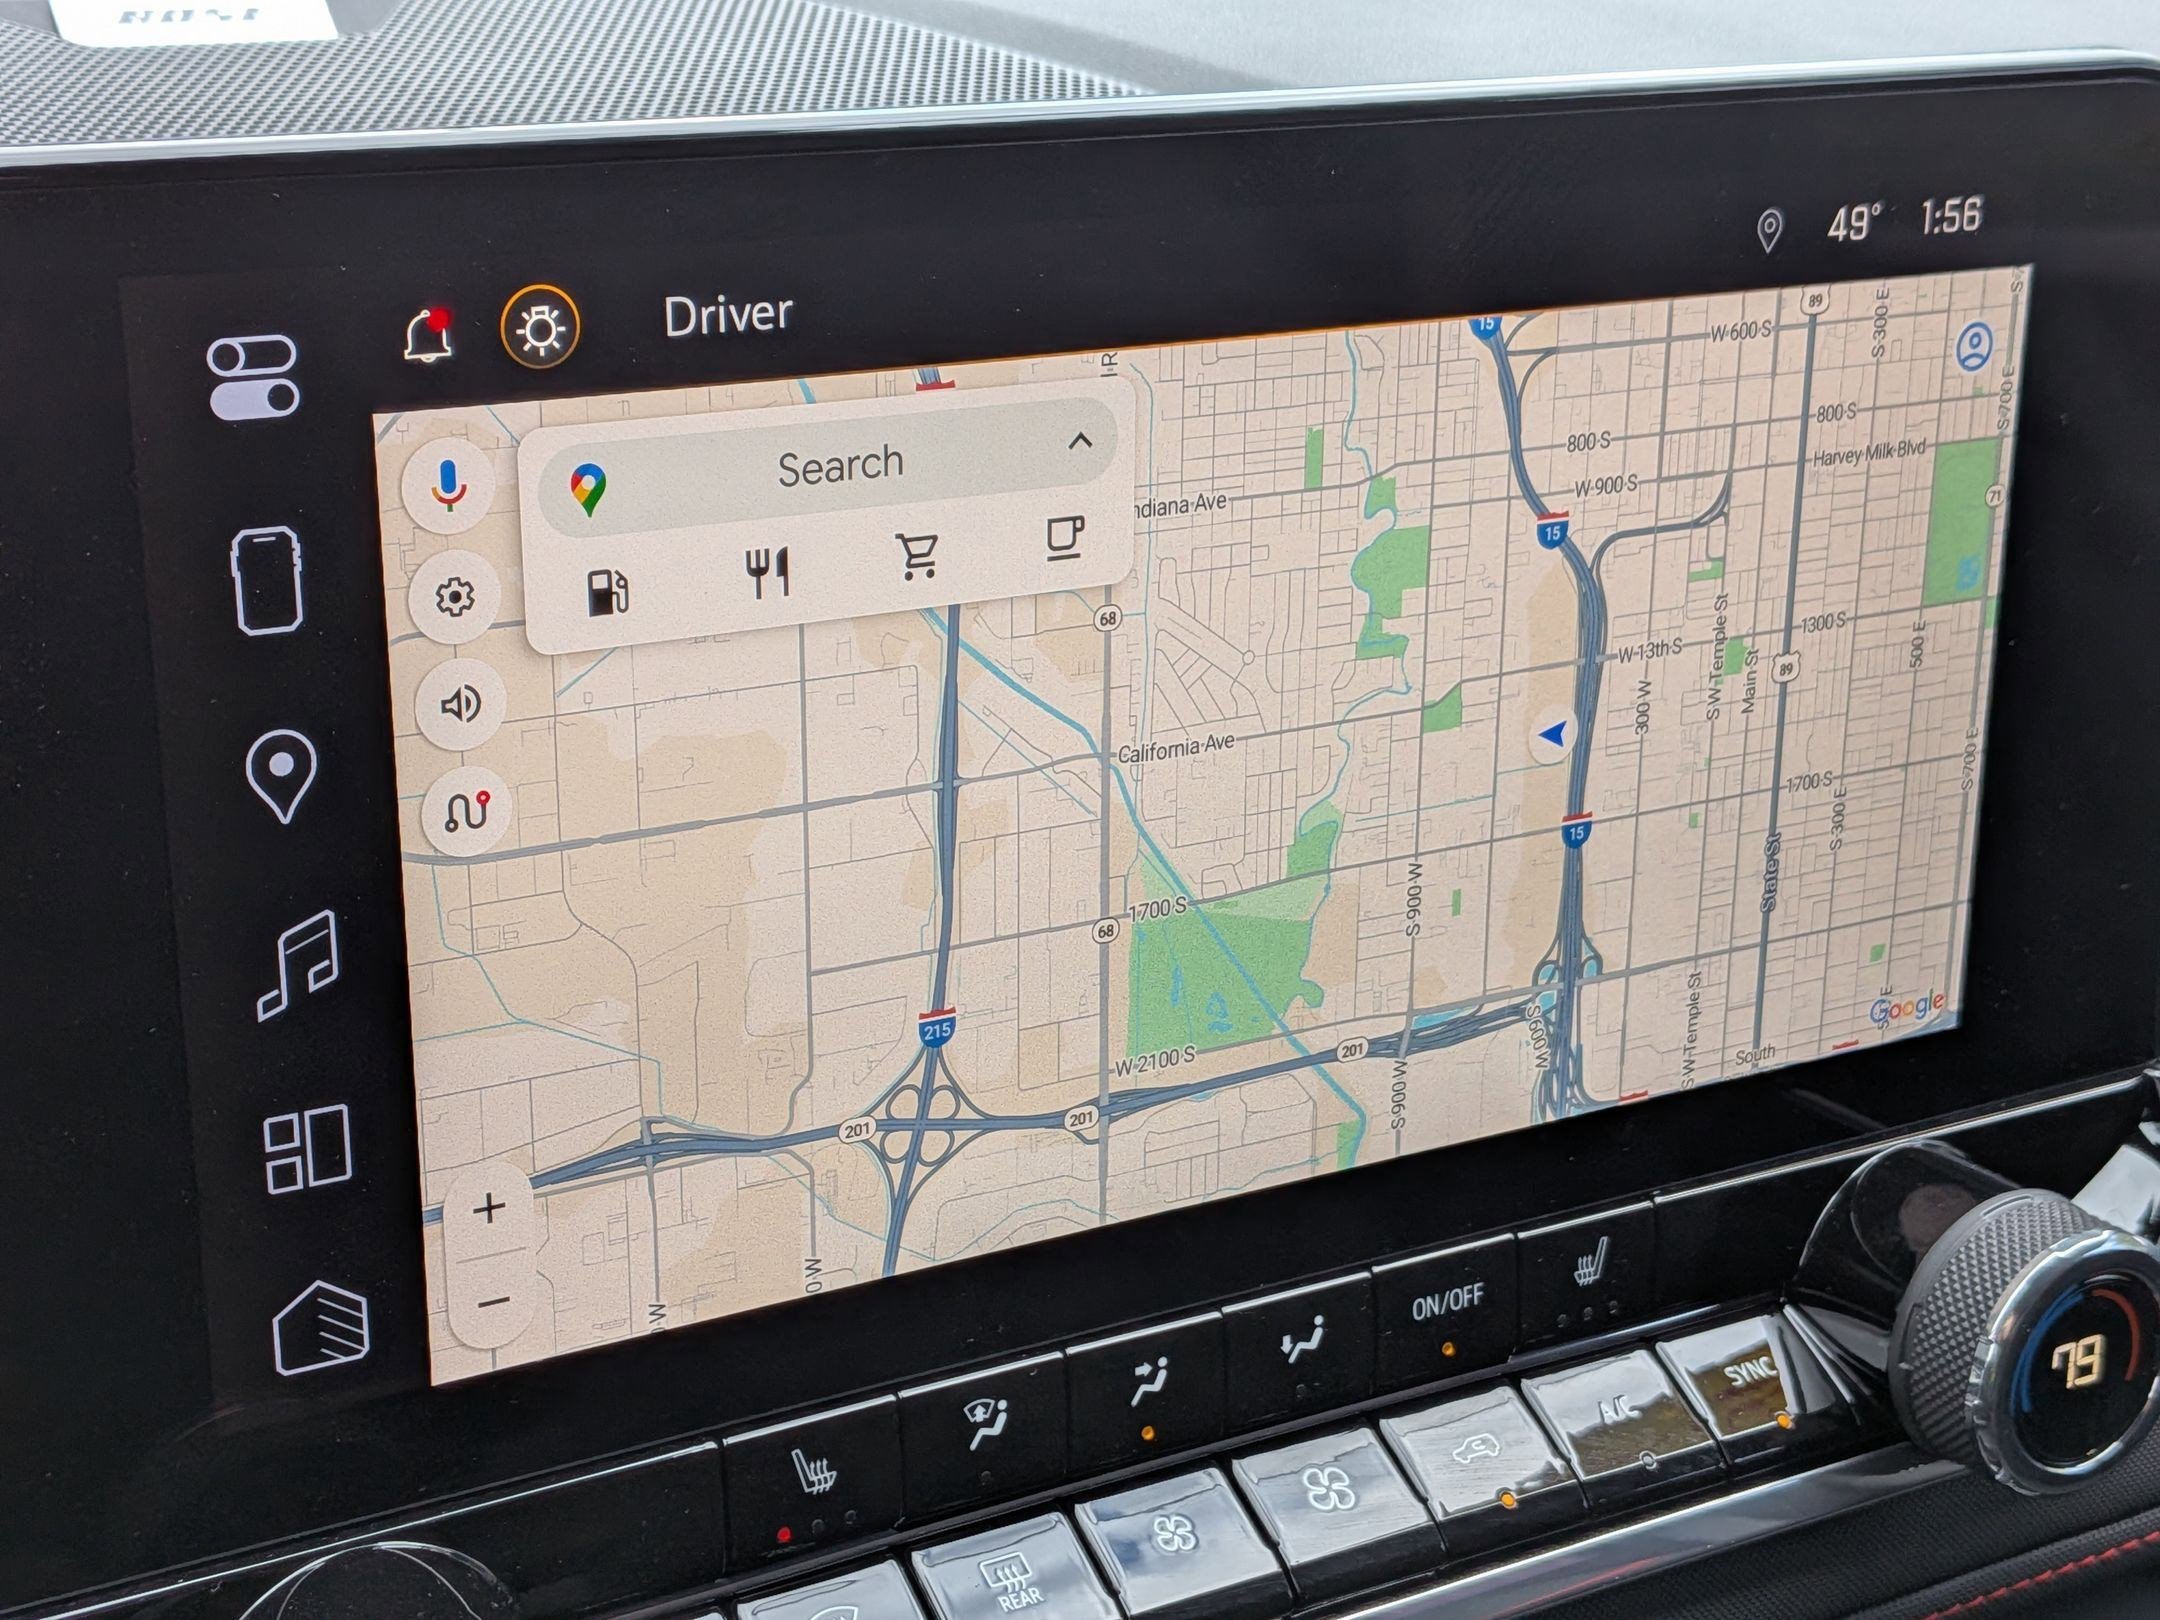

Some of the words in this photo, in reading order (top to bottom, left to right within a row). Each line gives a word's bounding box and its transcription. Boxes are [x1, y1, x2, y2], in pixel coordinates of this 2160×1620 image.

[1828, 202, 1882, 242] 49°
[1922, 195, 1985, 235] 1:56
[1809, 294, 1823, 307] 89
[1877, 288, 1889, 300] E
[665, 294, 793, 337] Driver
[1480, 317, 1494, 330] 15
[1874, 305, 1888, 341] 300
[1711, 326, 1726, 342] W
[1730, 322, 1758, 340] 600
[1762, 320, 1771, 336] S
[1872, 344, 1885, 358] S
[2002, 366, 2014, 377] E
[1998, 382, 2012, 416] 700
[1817, 404, 1843, 422] 800
[1847, 403, 1856, 419] S
[1997, 420, 2009, 430] S
[1567, 433, 1596, 452] 800
[1600, 431, 1611, 447] S
[1813, 448, 1862, 467] Harvey
[1866, 444, 1893, 460] Milk
[1898, 438, 1926, 457] Blvd
[779, 443, 903, 487] Search
[1575, 480, 1591, 498] W
[1595, 476, 1624, 494] 900
[1627, 474, 1638, 490] S
[1194, 493, 1227, 512] Ave
[1989, 490, 2001, 503] 71
[1545, 526, 1560, 540] 15
[1715, 593, 1728, 611] St
[1100, 611, 1117, 626] 68
[1801, 615, 1833, 633] 1300
[1836, 612, 1846, 626] S
[1914, 621, 1926, 632] E
[1619, 649, 1635, 663] W
[1638, 640, 1672, 659] 13th
[1673, 637, 1683, 653] S
[1711, 614, 1727, 680] Temple
[1910, 636, 1924, 668] 500
[1745, 649, 1759, 666] St
[1780, 663, 1793, 676] 89
[1637, 681, 1651, 698] W
[1708, 687, 1721, 705] W
[1741, 671, 1757, 714] Main
[1635, 702, 1650, 735] 300
[1707, 709, 1720, 720] S
[1966, 728, 1979, 738] E
[1118, 738, 1200, 764] California
[1204, 734, 1235, 752] Ave
[1963, 743, 1976, 777] 700
[1786, 775, 1819, 793] 1700
[1822, 772, 1833, 786] S
[1834, 786, 1847, 797] E
[1962, 779, 1974, 791] S
[1831, 802, 1846, 834] 300
[1569, 826, 1584, 839] 15
[1766, 832, 1782, 853] St
[1830, 839, 1843, 850] S
[1408, 863, 1423, 882] W
[1761, 855, 1780, 912] State
[1129, 899, 1170, 923] 1700
[1175, 896, 1187, 914] S
[1407, 885, 1422, 920] 900
[1097, 924, 1114, 939] 68
[1405, 923, 1420, 937] S
[1688, 970, 1702, 988] St
[1527, 1005, 1541, 1018] S
[1870, 988, 1945, 1024] Google
[1683, 989, 1700, 1054] Temple
[924, 1023, 951, 1041] 215
[1529, 1019, 1547, 1050] 600
[1341, 1043, 1365, 1059] 201
[1535, 1050, 1549, 1068] W
[1735, 1044, 1776, 1066] South
[1115, 1060, 1135, 1077] W
[1137, 1050, 1180, 1074] 2100
[1184, 1045, 1196, 1063] S
[1392, 1060, 1407, 1078] W
[1682, 1058, 1695, 1077] W
[1681, 1078, 1694, 1090] S
[1391, 1080, 1407, 1115] 900
[1069, 1111, 1094, 1128] 201
[1391, 1117, 1405, 1130] S
[845, 1122, 871, 1139] 201
[805, 1258, 822, 1278] W
[1412, 1282, 1485, 1322] ON/OFF
[2052, 1333, 2105, 1390] 79
[1723, 1356, 1778, 1388] SYNC
[1599, 1394, 1642, 1424] A/C
[999, 1586, 1044, 1613] REAR
